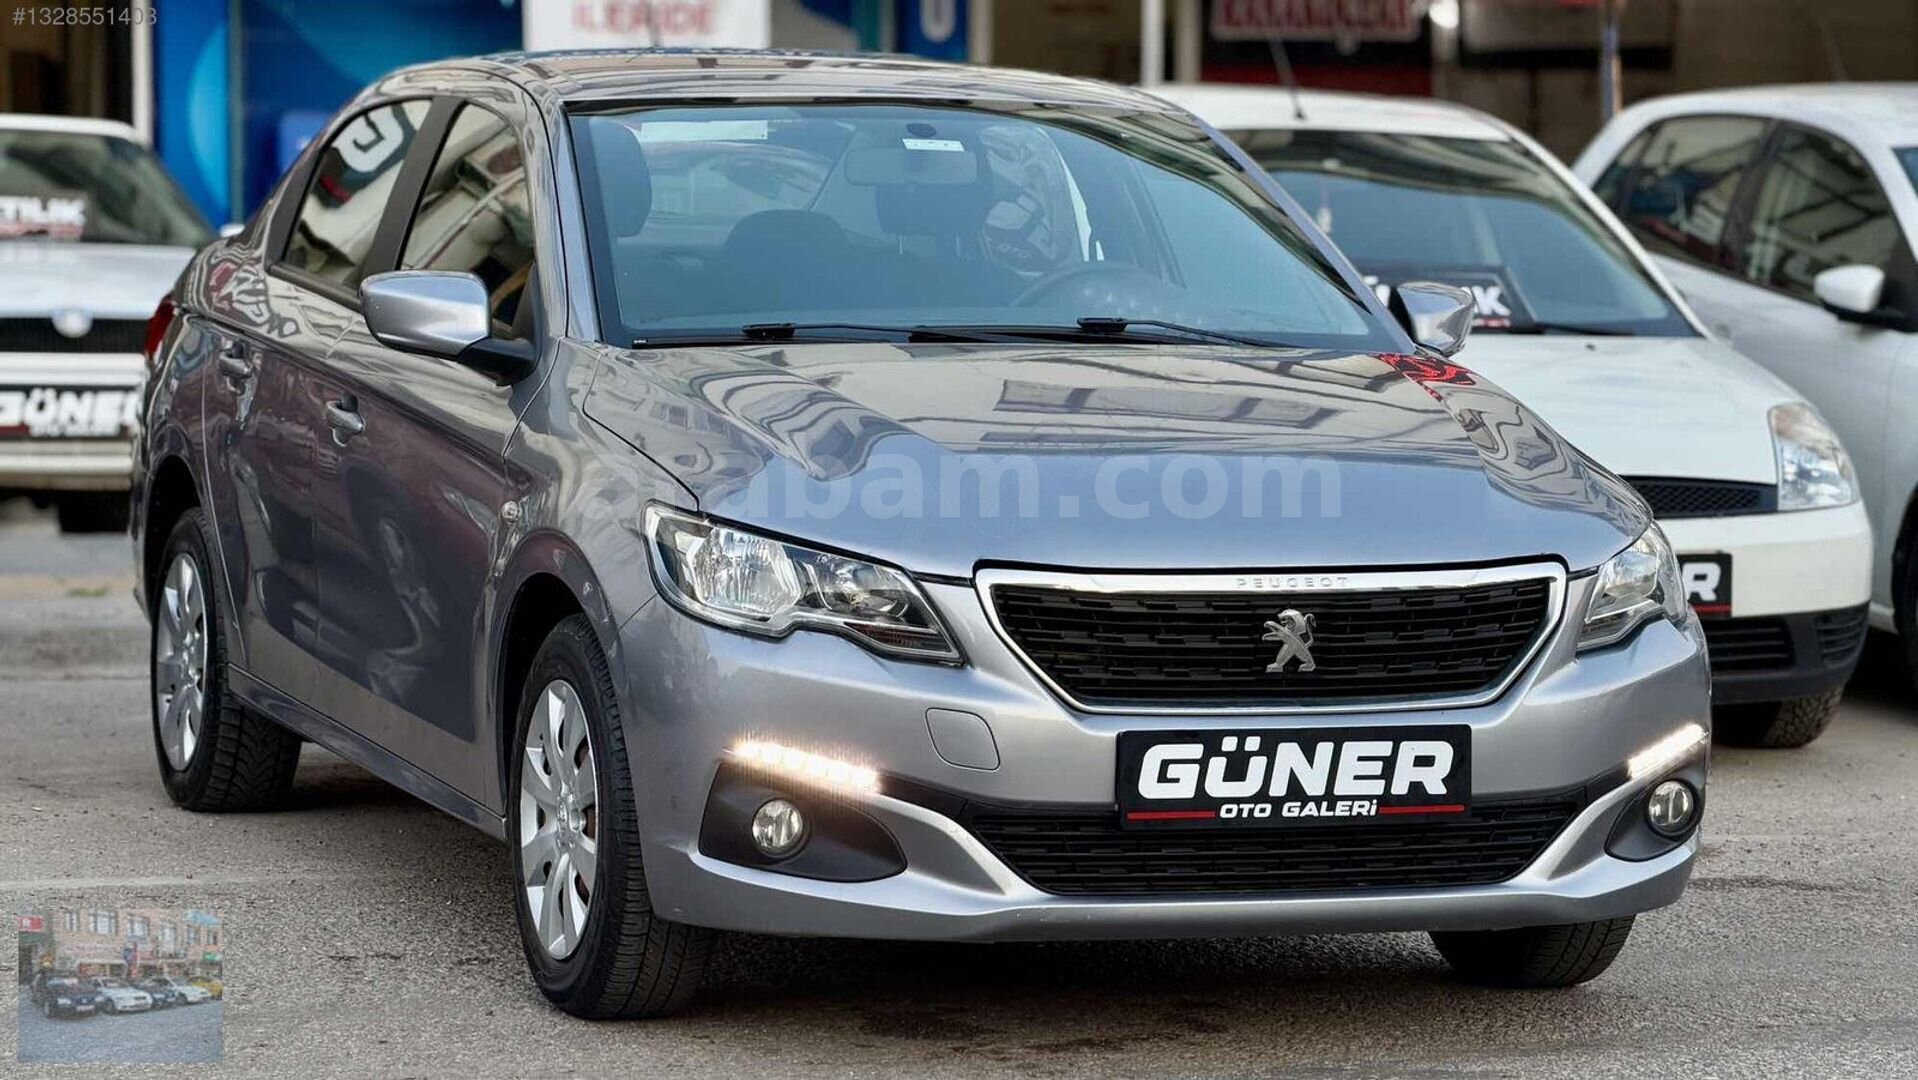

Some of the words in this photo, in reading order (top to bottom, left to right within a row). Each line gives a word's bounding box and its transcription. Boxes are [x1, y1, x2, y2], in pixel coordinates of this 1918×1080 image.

[1236, 577, 1348, 589] PEUGEOT
[1138, 736, 1454, 799] GÜNER
[1219, 803, 1271, 819] OTO
